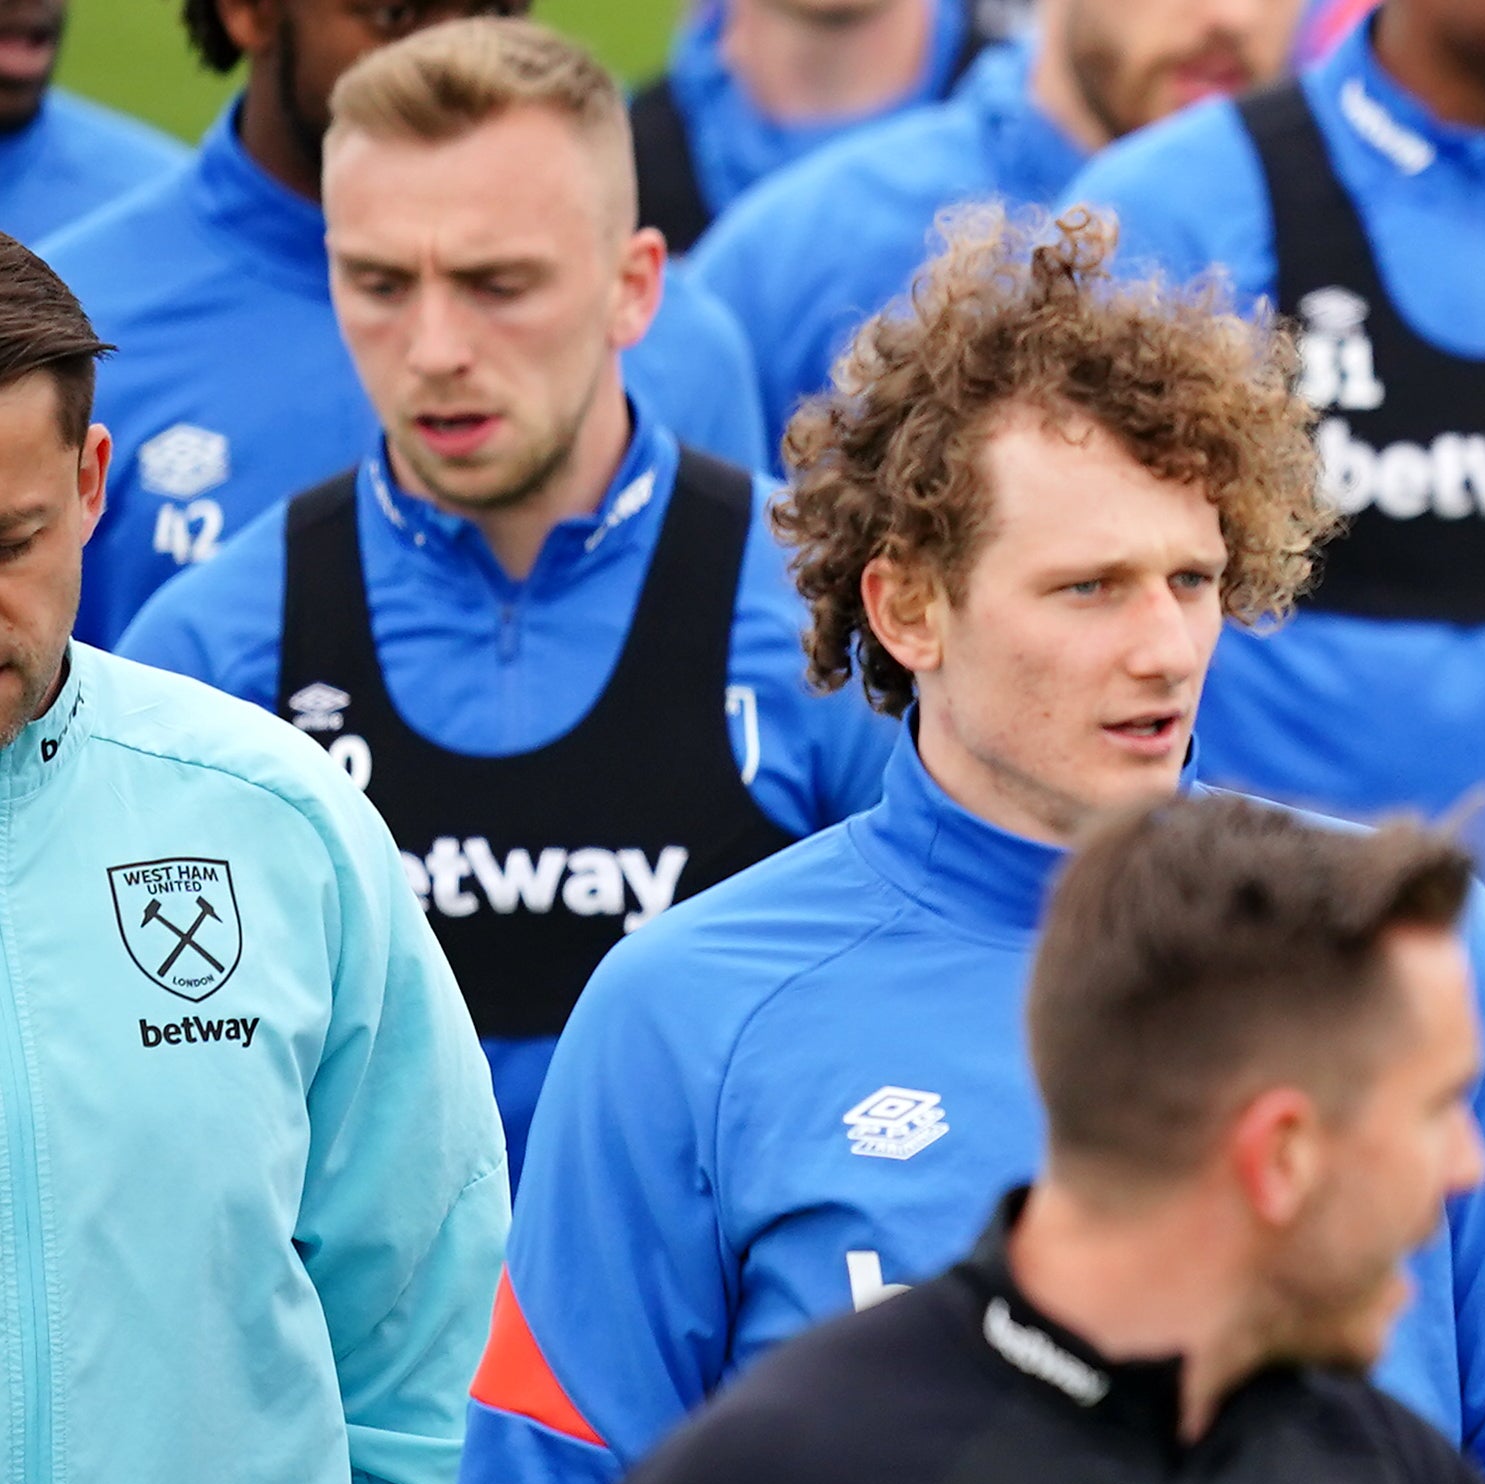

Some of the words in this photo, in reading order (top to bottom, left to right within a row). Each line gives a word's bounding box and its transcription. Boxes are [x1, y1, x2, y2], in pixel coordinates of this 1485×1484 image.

[328, 734, 371, 792] 0
[123, 866, 173, 886] WEST
[178, 865, 219, 882] HAM
[147, 880, 202, 895] UNITED
[400, 836, 688, 933] etway
[172, 974, 215, 987] LONDON
[139, 1016, 260, 1048] betway
